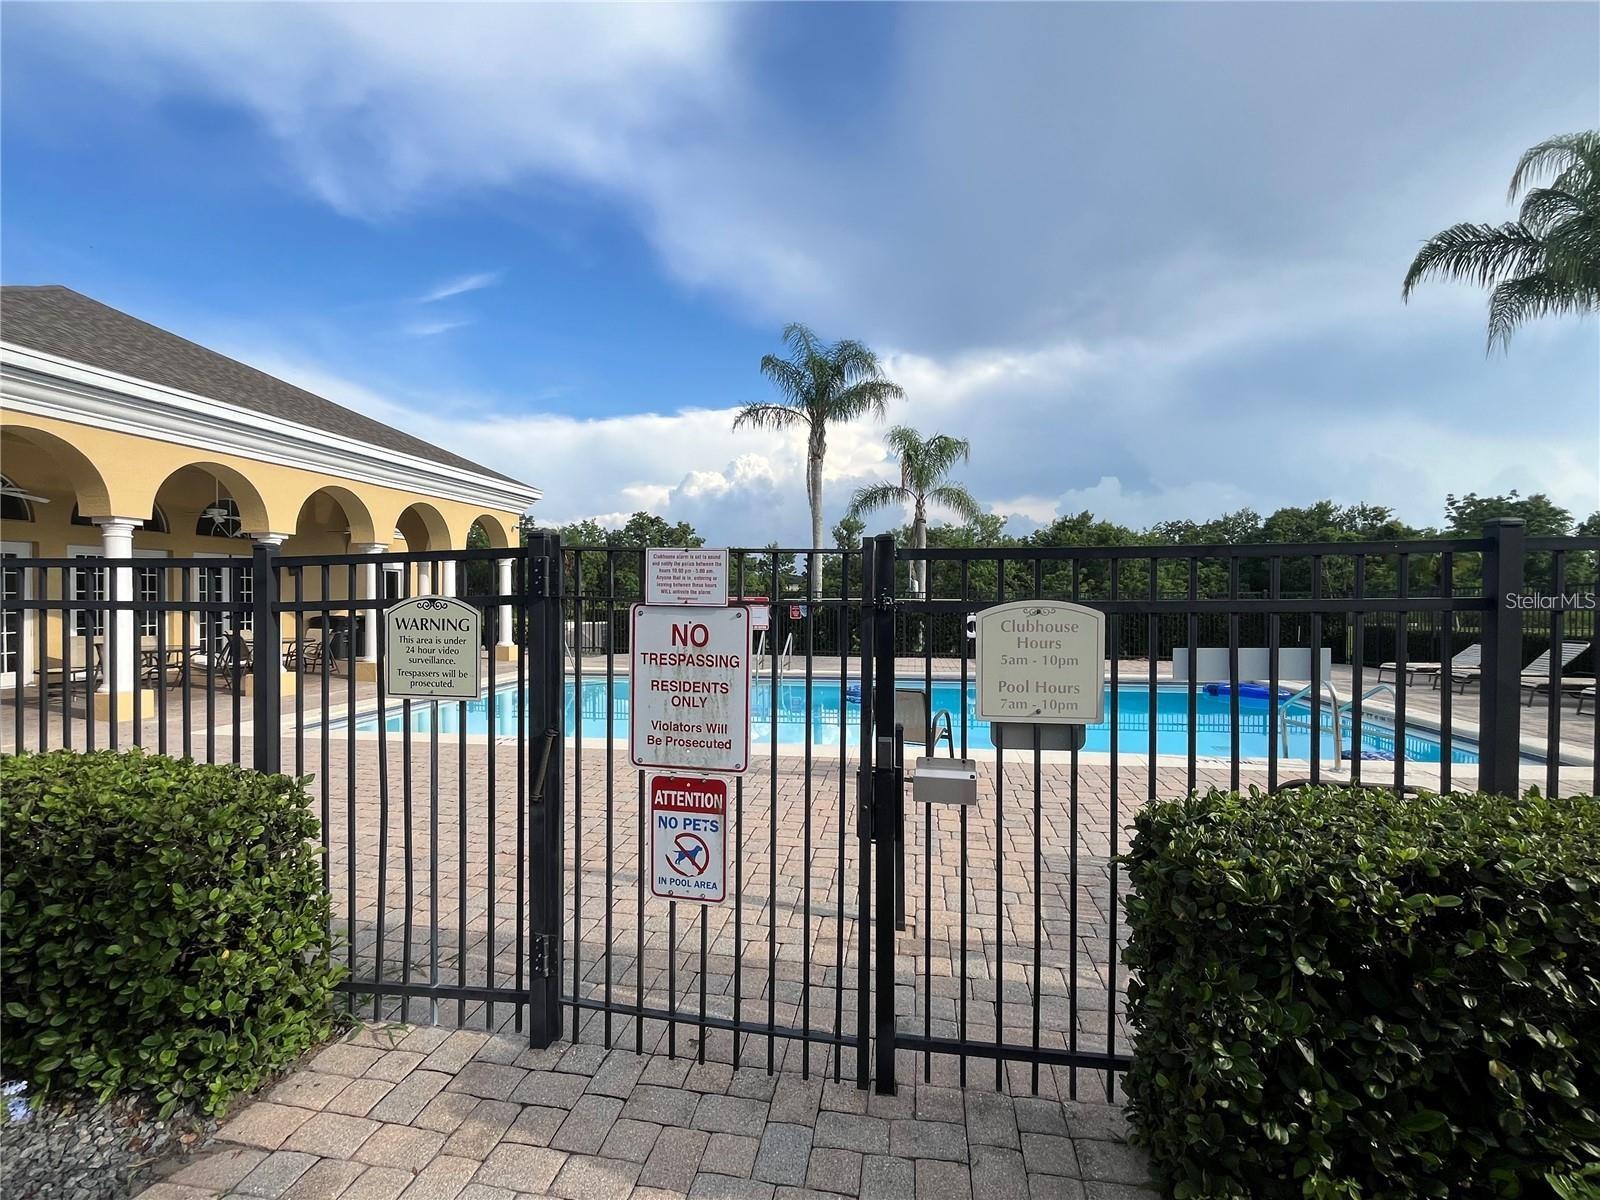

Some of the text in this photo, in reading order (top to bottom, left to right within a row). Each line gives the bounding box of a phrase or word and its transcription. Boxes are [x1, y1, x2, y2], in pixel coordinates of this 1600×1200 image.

[395, 618, 470, 631] WARNING
[1001, 620, 1079, 633] Clubhouse
[444, 636, 466, 644] under
[671, 623, 709, 647] NO
[1017, 637, 1061, 649] Hours
[439, 647, 459, 655] video
[408, 656, 456, 664] surveillance.
[640, 652, 740, 668] TRESPASSING
[1000, 655, 1028, 665] 5am
[1043, 655, 1079, 668] 10pm
[397, 669, 440, 678] Trespassers
[410, 680, 454, 688] prosecuted.
[651, 680, 729, 694] RESIDENTS
[998, 680, 1080, 694] Pool Hours
[671, 696, 707, 708] ONLY
[1000, 699, 1027, 709] 7am
[1042, 700, 1078, 713] 10pm
[651, 720, 728, 734] Violators Will
[647, 735, 732, 749] Be Prosecuted
[654, 790, 722, 808] ATTENTION
[658, 816, 719, 832] NO PETS
[670, 878, 691, 887] POOL
[694, 880, 717, 890] AREA
